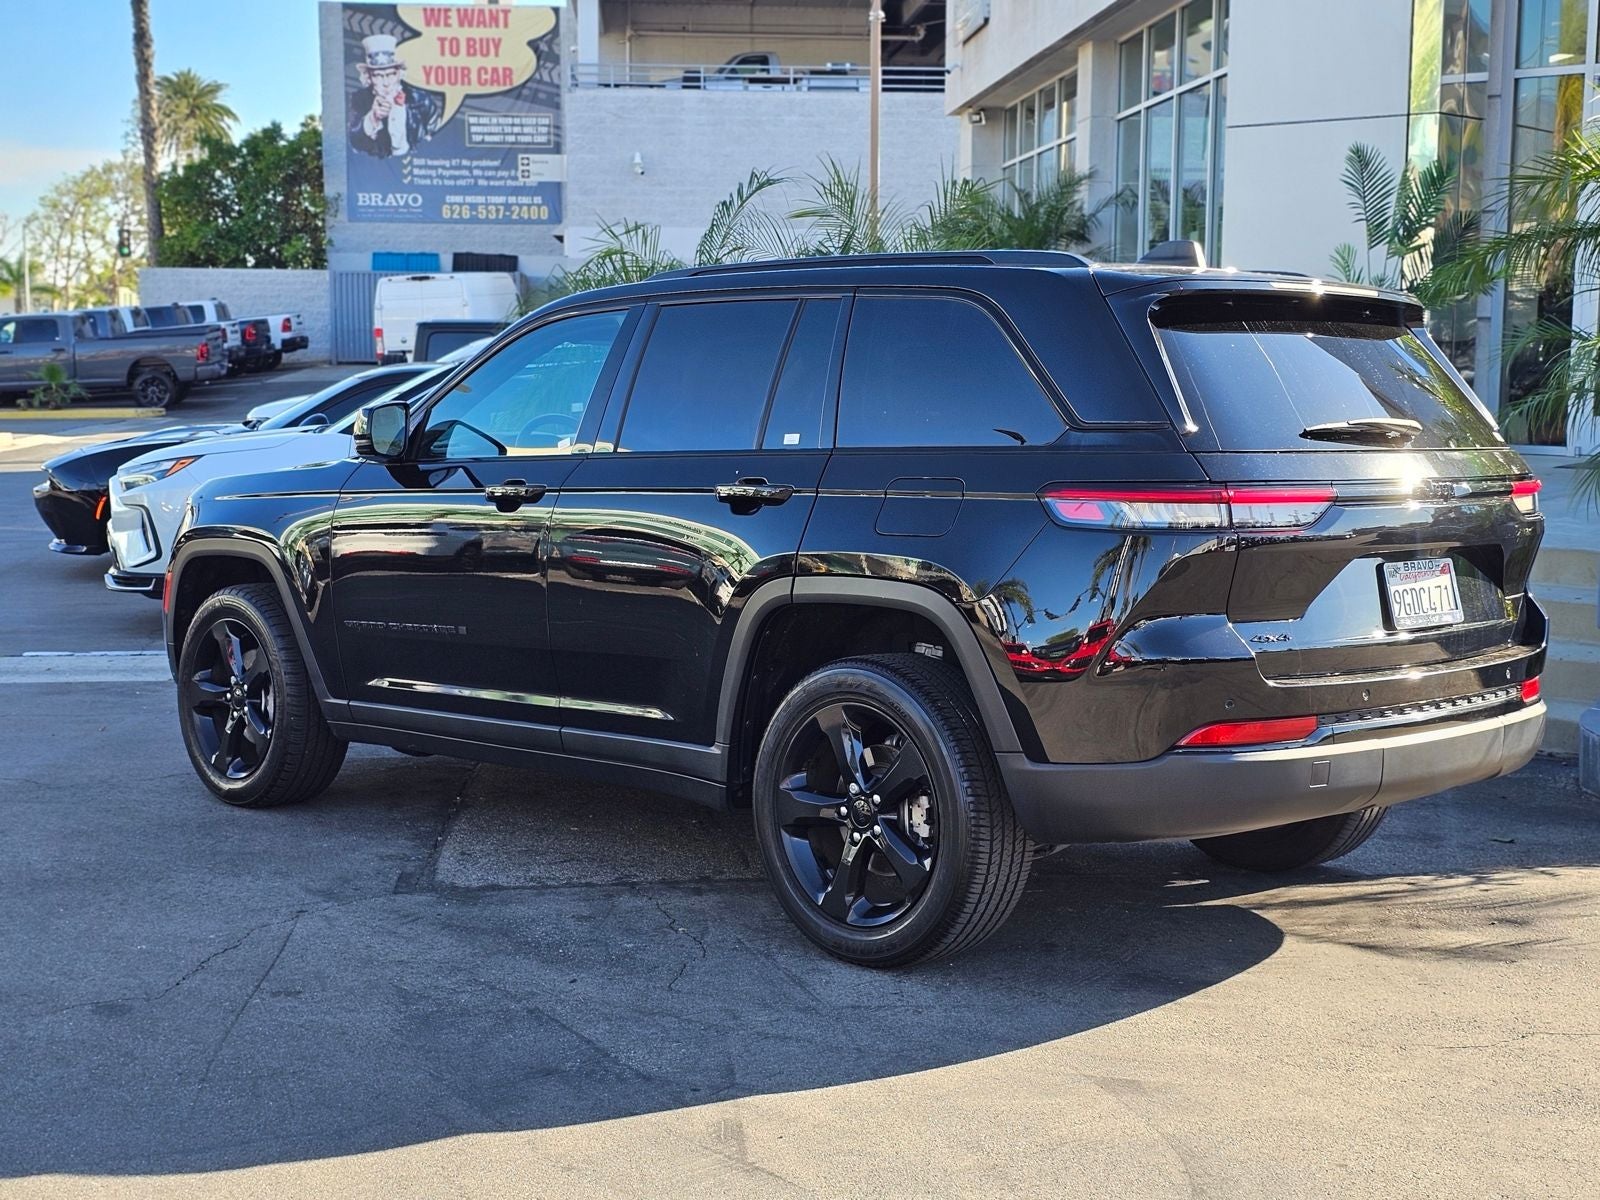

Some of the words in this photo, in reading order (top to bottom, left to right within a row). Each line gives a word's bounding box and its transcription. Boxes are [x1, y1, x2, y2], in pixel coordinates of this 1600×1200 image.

[422, 7, 453, 28] WE
[456, 8, 512, 29] WANT
[437, 36, 461, 57] TO
[465, 37, 503, 58] BUY
[422, 65, 472, 86] YOUR
[476, 66, 514, 87] CAR
[461, 159, 471, 167] No
[413, 168, 437, 177] Making
[473, 169, 483, 177] We
[497, 170, 509, 178] pay
[413, 178, 432, 187] Think
[477, 179, 488, 187] We
[357, 193, 423, 207] BRAVO
[445, 195, 464, 204] COME
[507, 196, 517, 204] OR
[517, 196, 533, 204] CALL
[533, 196, 543, 204] US
[442, 204, 549, 220] 626-537-2400
[1403, 560, 1434, 571] BRAVO
[1393, 585, 1453, 617] 9GDC471
